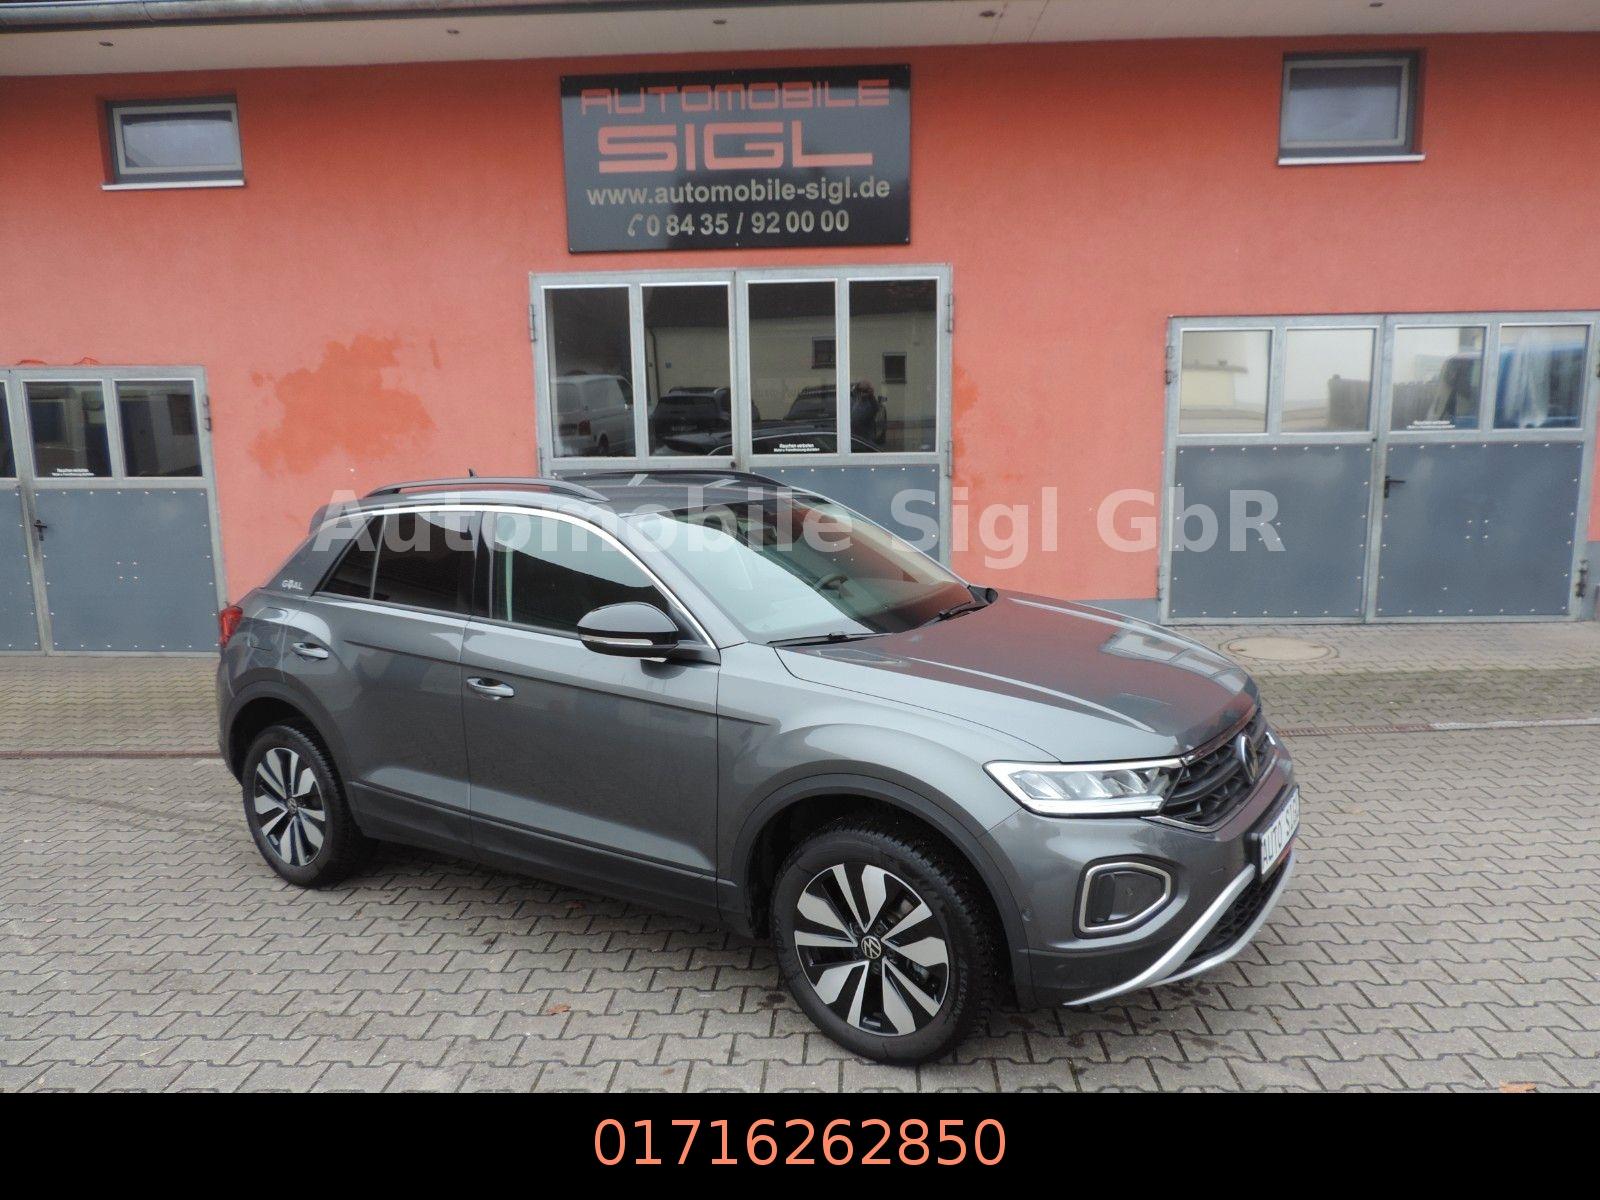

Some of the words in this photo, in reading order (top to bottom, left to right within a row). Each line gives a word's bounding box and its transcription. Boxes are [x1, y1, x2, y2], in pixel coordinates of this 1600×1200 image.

[580, 79, 890, 115] AUTOMOBILE
[598, 120, 873, 173] SIGL
[586, 176, 891, 206] www.automobile-sigl.de
[646, 214, 661, 237] 0
[666, 213, 695, 236] 84
[700, 212, 729, 235] 35
[751, 211, 780, 233] 92
[786, 210, 815, 233] 00
[820, 209, 850, 232] 00
